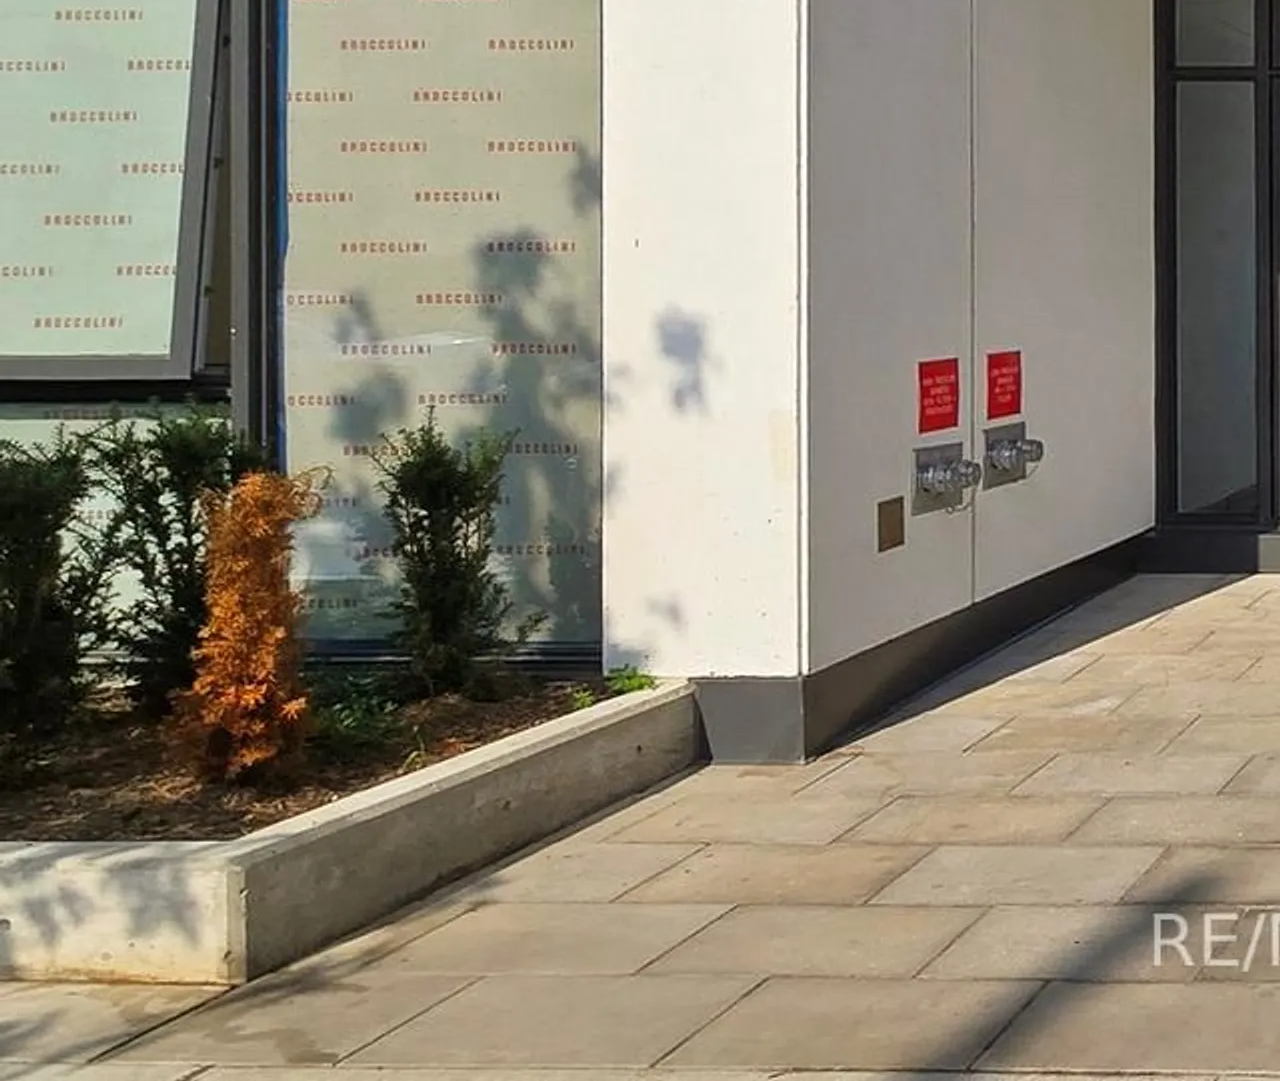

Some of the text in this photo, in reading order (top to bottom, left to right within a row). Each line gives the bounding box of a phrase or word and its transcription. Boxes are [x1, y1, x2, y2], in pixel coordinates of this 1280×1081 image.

[55, 10, 142, 20] BROCCOLINI
[341, 40, 574, 50] BROCCOLINI BROCCOLINI
[413, 91, 502, 102] BROCCOLINI
[50, 111, 137, 122] BROCCOLINI
[341, 142, 577, 152] BROCCOLINI BROCCOLINI
[415, 191, 500, 202] BROCCOLINI
[45, 215, 132, 225] BROCCOLINI
[341, 242, 576, 253] BROCCOLINI BROCCOLINI
[416, 294, 502, 304] BROCCOLINI
[34, 318, 122, 328] BROCCOLINI
[341, 343, 577, 355] BROCCOLINI BROCCOLINI
